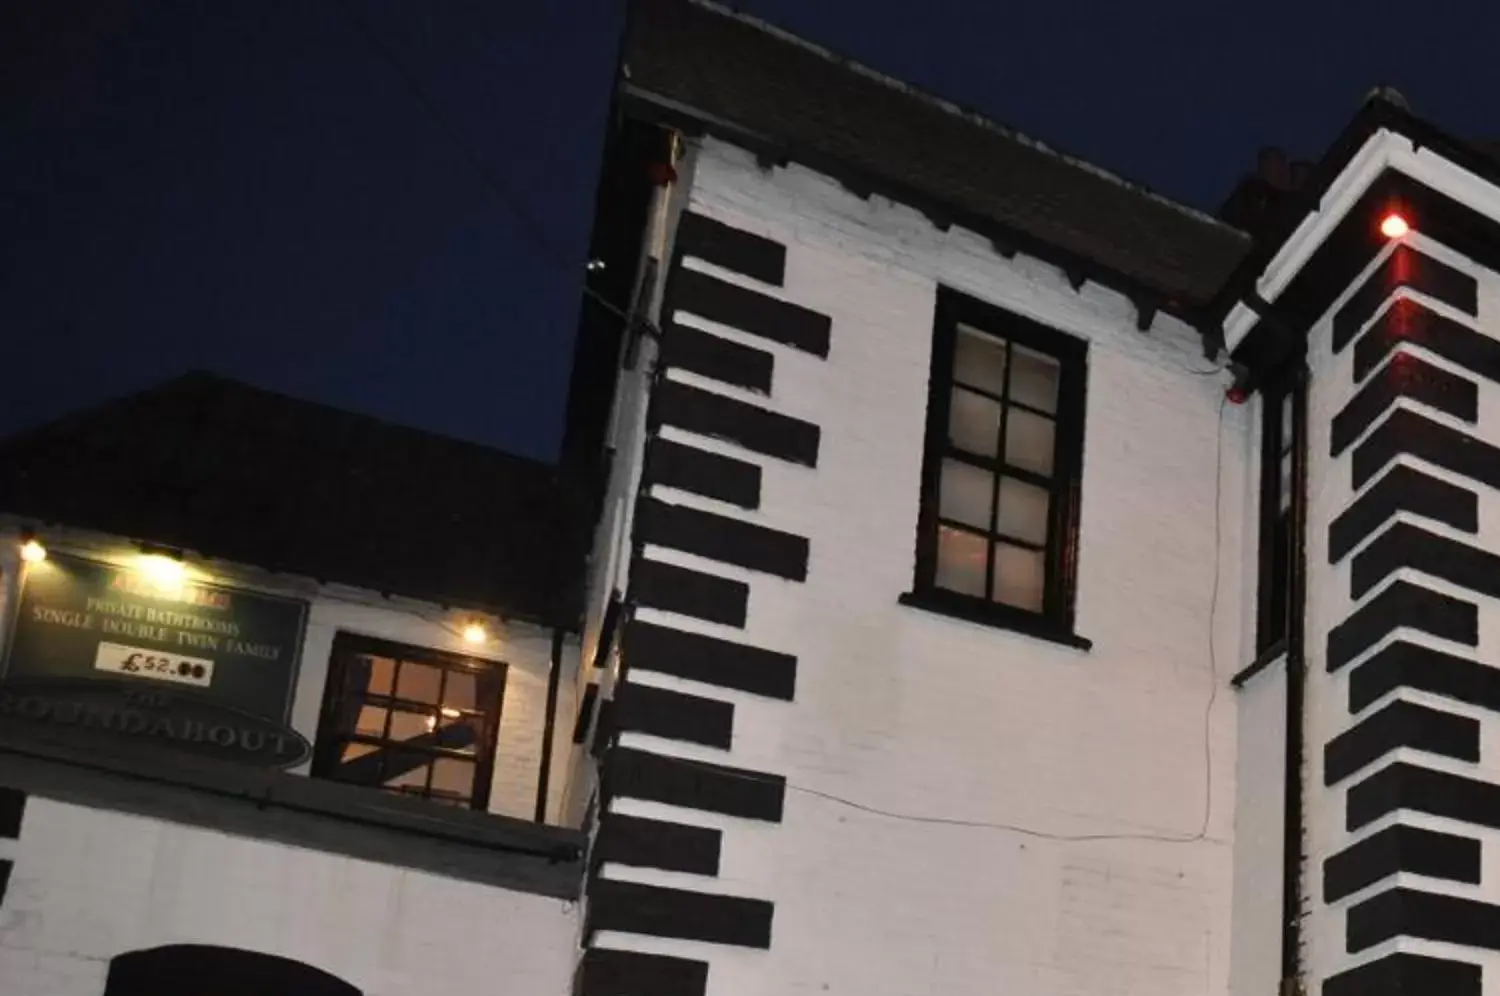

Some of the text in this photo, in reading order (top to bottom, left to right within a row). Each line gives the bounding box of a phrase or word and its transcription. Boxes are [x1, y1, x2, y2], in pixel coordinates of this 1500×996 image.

[33, 607, 280, 660] SINGLE DOUBLE TWIN FAMILY
